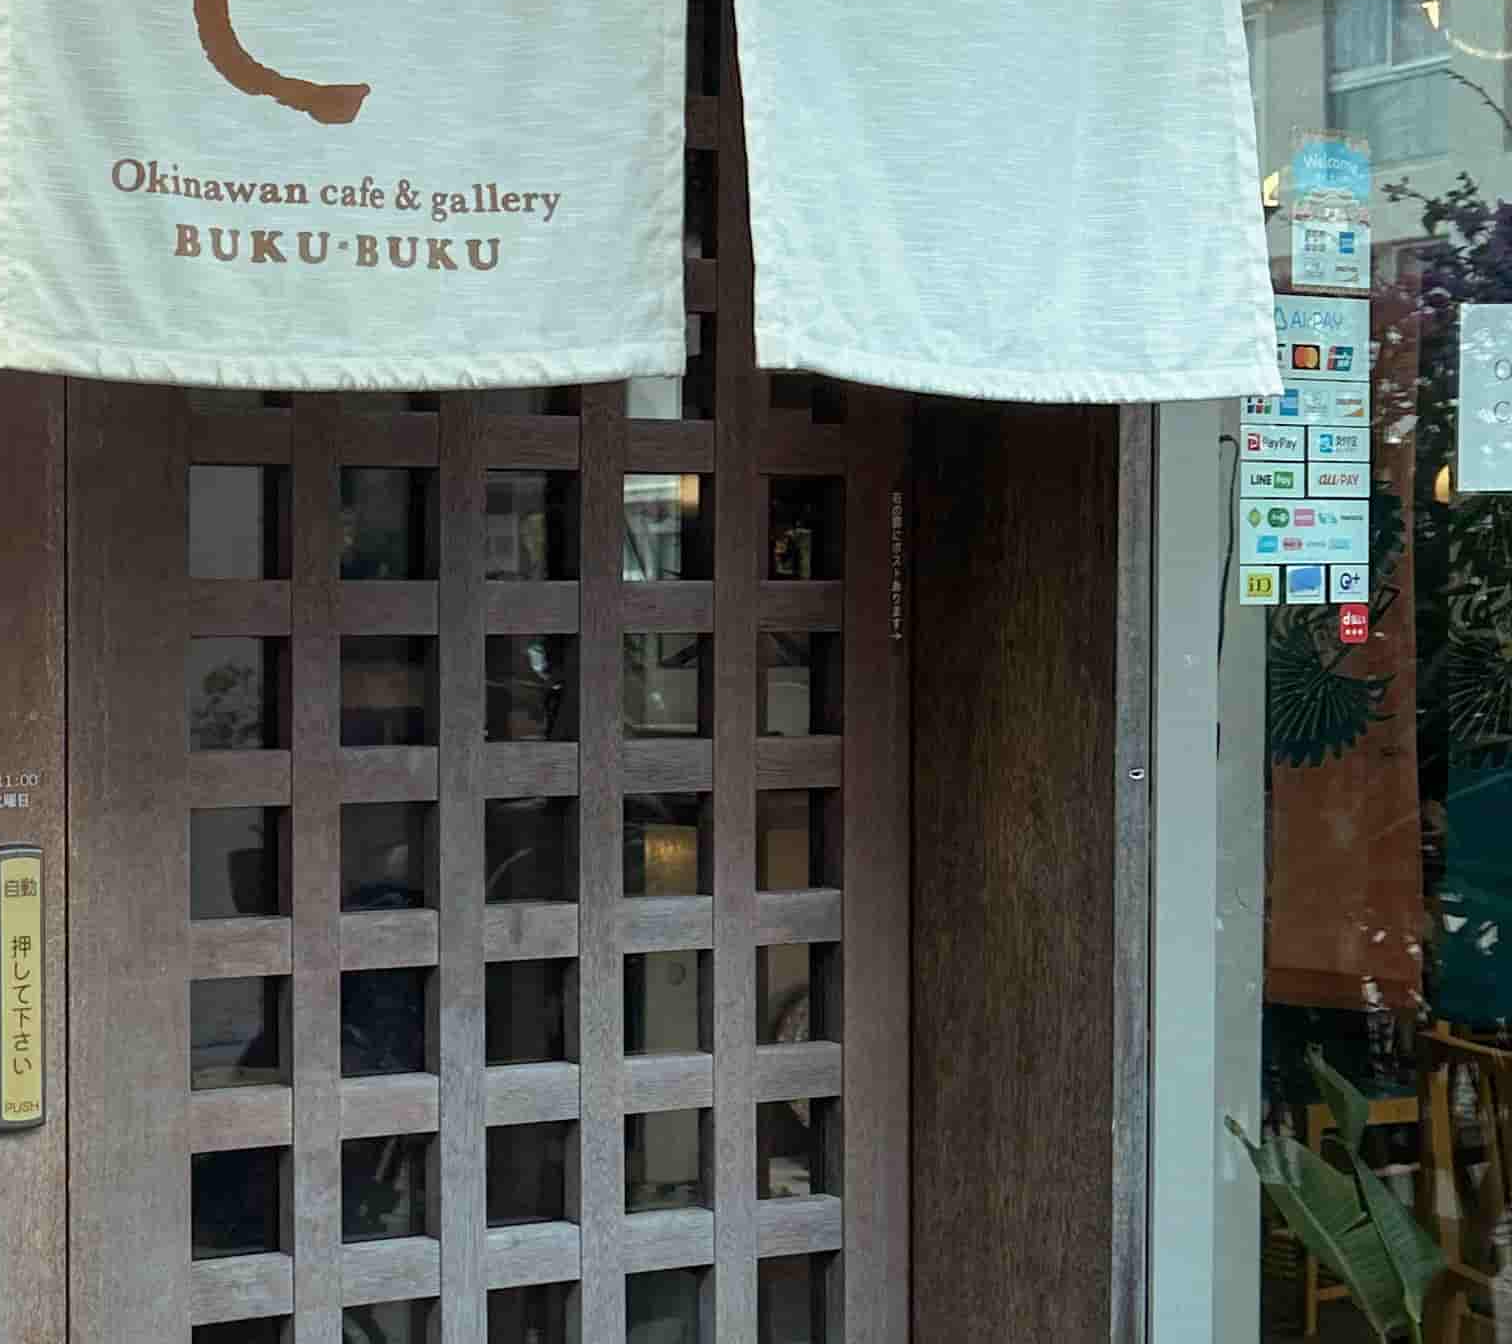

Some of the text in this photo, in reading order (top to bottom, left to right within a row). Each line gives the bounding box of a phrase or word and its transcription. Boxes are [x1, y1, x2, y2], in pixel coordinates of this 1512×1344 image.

[111, 158, 562, 222] Okinawan cafe & gallery
[1250, 474, 1272, 485] LINE
[5, 877, 38, 899] 自動
[10, 935, 33, 1074] 押して下さい
